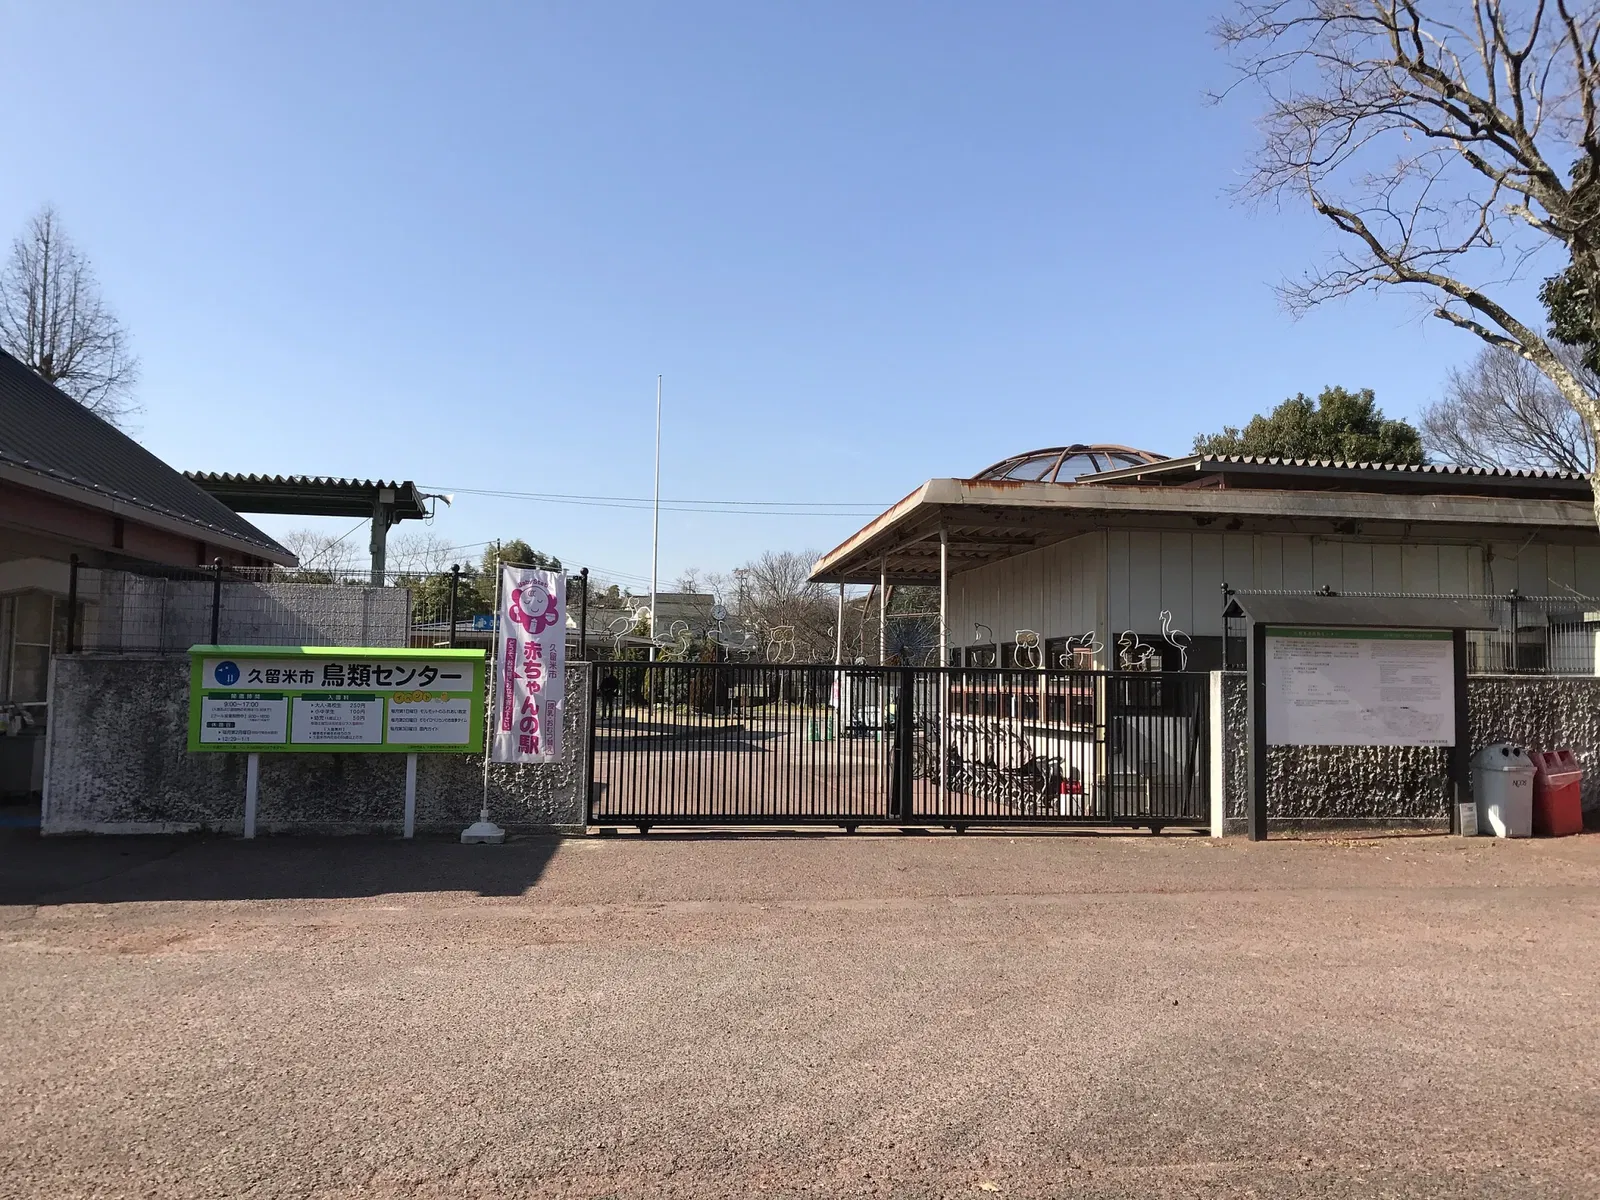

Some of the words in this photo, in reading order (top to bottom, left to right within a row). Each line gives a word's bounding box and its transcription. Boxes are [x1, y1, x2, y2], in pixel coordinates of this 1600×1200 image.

[247, 668, 314, 685] 久留米市
[321, 662, 462, 687] 鳥類センター
[548, 643, 557, 679] 久留米市
[518, 641, 542, 754] 赤ちゃんの駅
